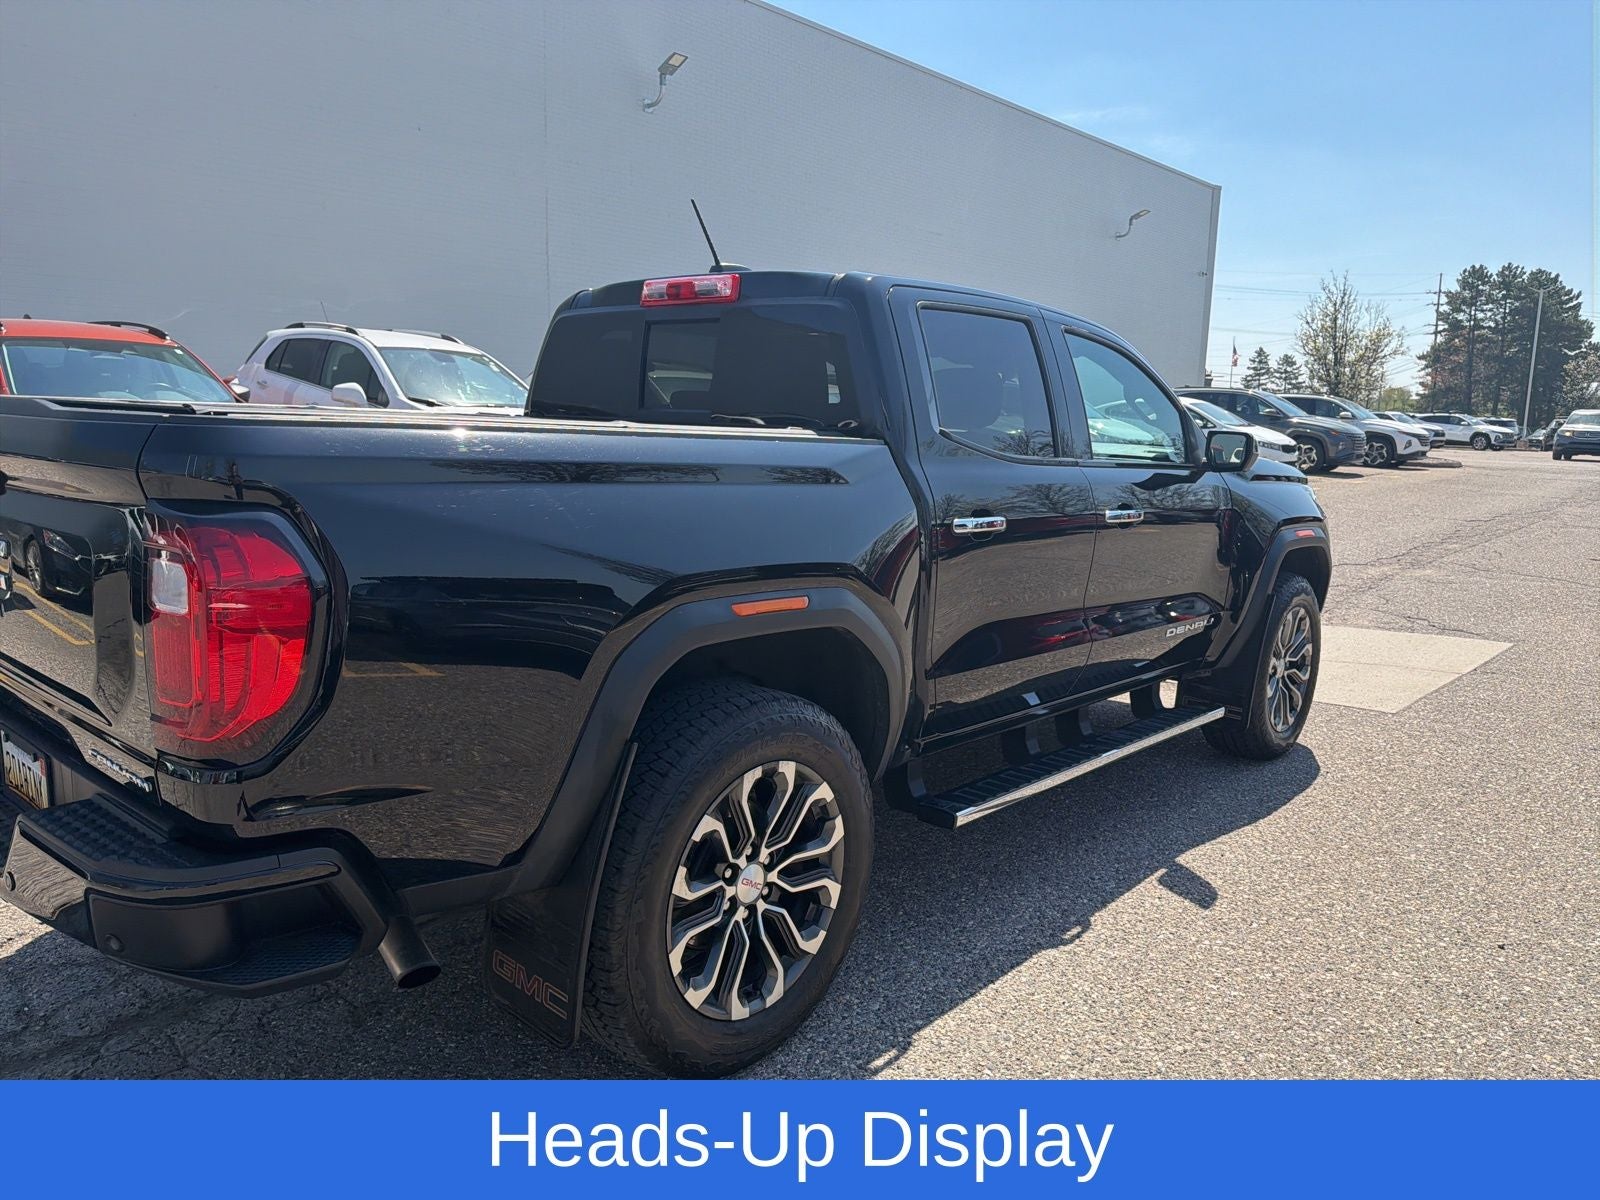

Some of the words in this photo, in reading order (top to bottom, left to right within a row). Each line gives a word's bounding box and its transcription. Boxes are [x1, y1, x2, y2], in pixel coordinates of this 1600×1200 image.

[1165, 617, 1215, 638] DENALI
[741, 877, 762, 891] GMC
[492, 948, 569, 1020] GMC
